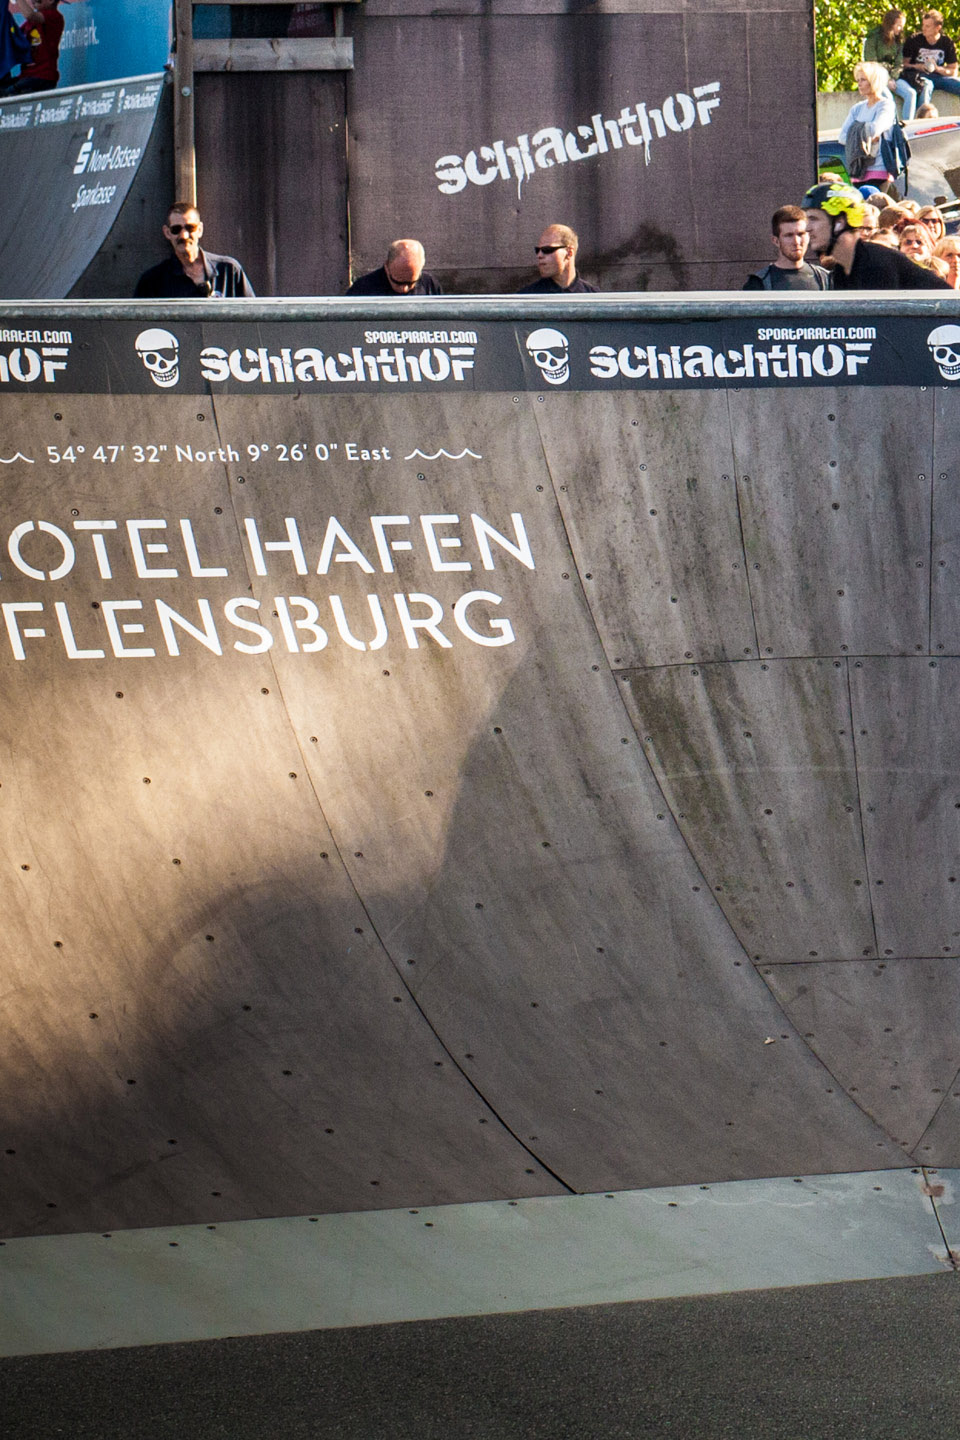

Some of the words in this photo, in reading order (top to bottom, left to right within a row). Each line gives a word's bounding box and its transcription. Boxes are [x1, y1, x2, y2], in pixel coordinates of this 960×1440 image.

[47, 445, 85, 463] 54°
[92, 445, 125, 463] 47'
[174, 444, 240, 463] North
[247, 444, 270, 462] 9°
[275, 444, 308, 462] 26'
[345, 443, 392, 461] East
[0, 518, 229, 581] OTEL
[244, 512, 536, 577] HAFEN
[1, 590, 516, 661] FLENSBURG
